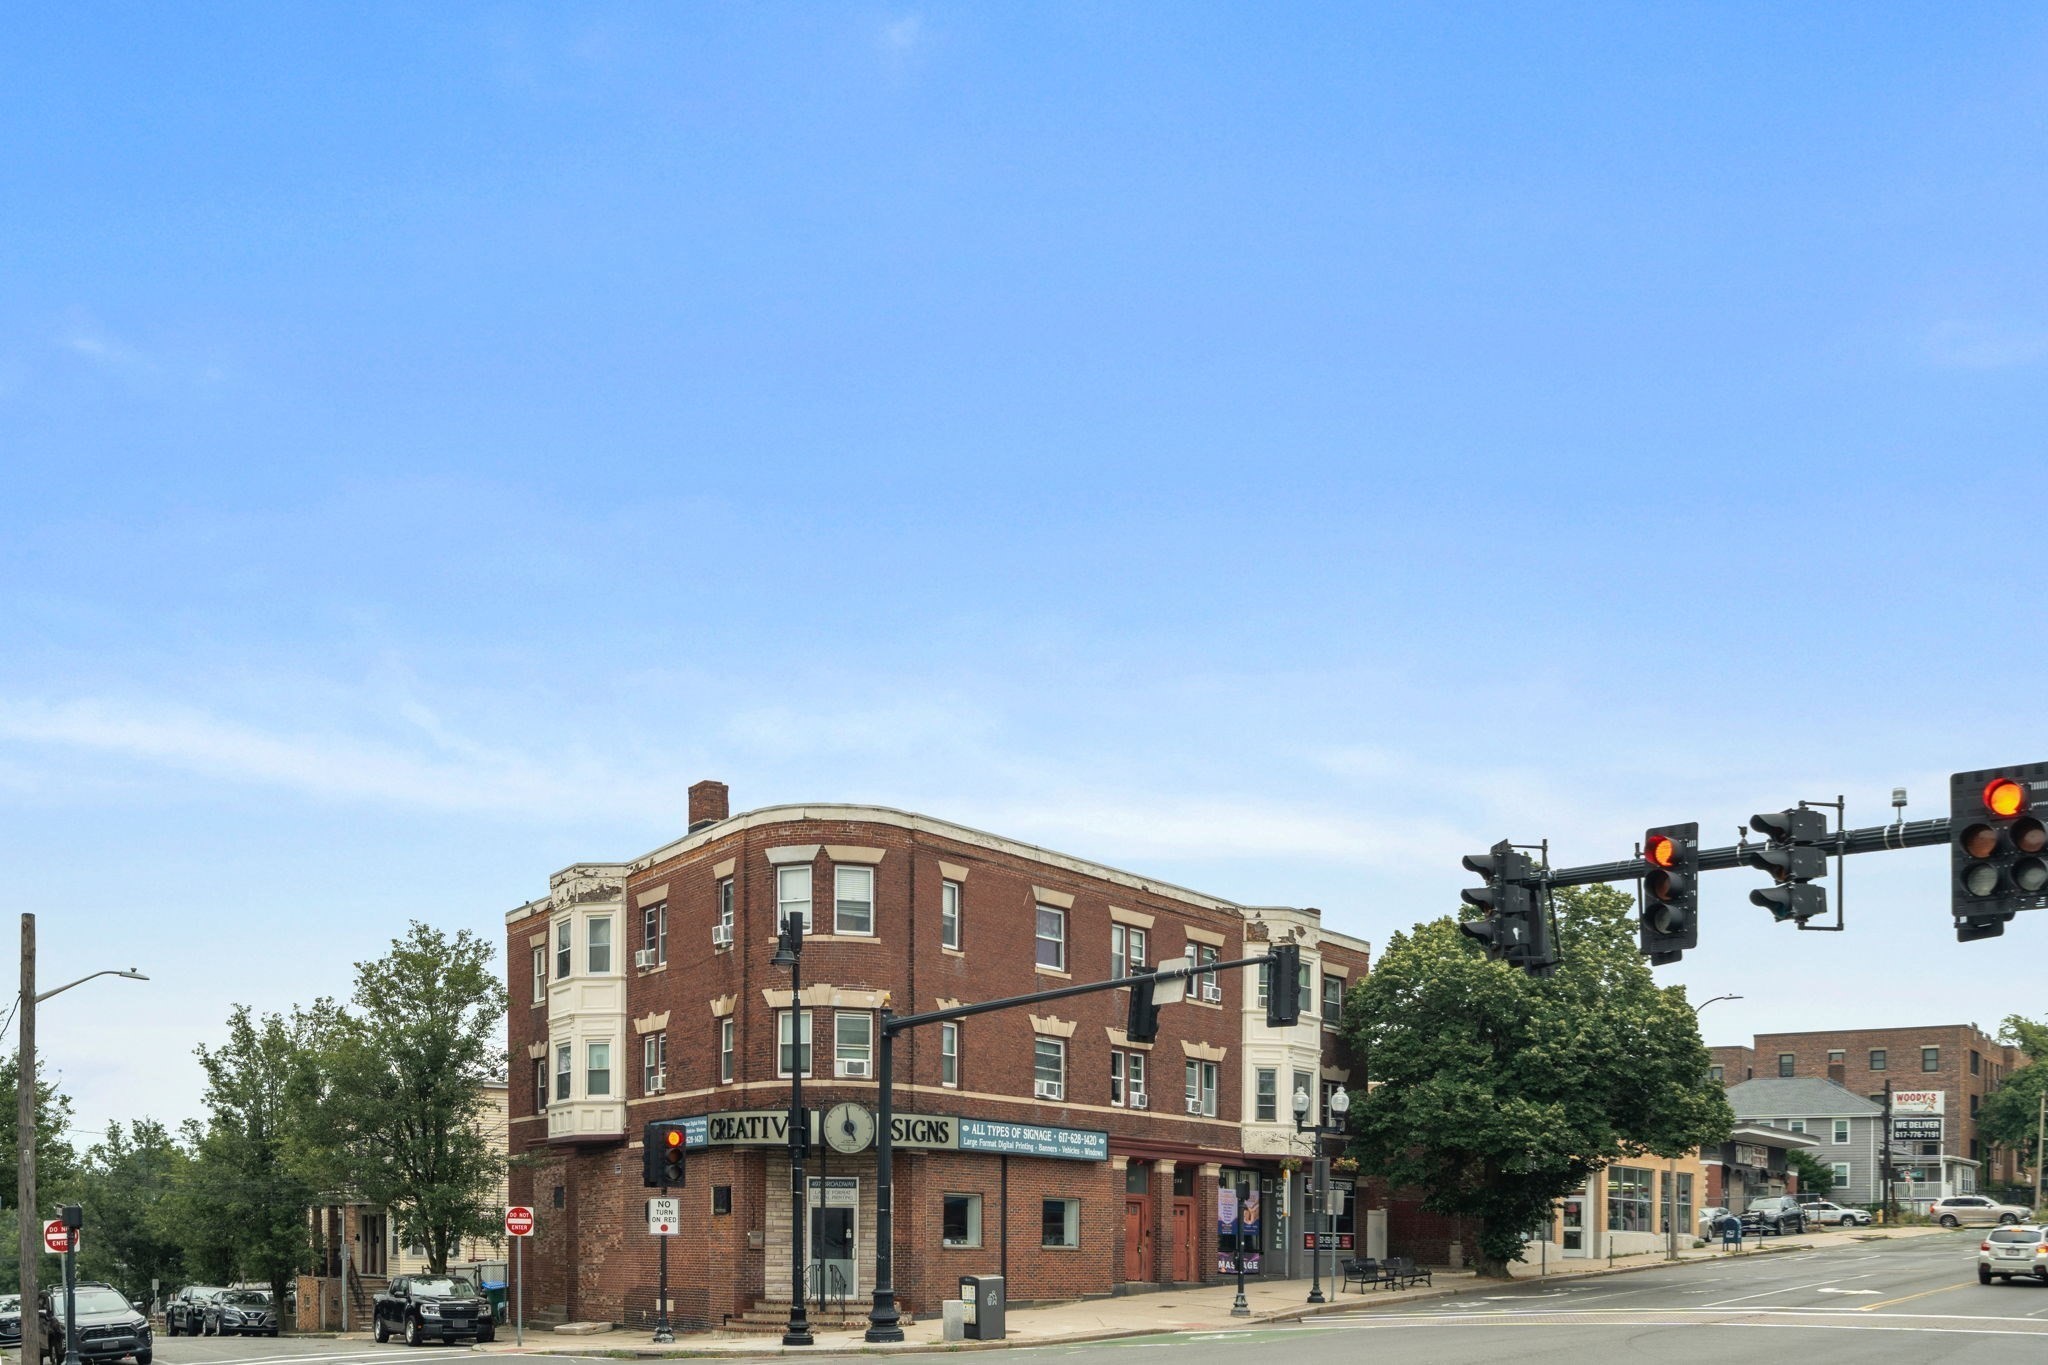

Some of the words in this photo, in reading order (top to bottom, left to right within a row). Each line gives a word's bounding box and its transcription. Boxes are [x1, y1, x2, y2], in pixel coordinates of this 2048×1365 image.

[1896, 1093, 1936, 1102] WOODY'S
[710, 1116, 788, 1141] CREATIV
[971, 1123, 985, 1135] ALL
[987, 1125, 1009, 1138] TYPES
[1011, 1127, 1021, 1138] OF
[1023, 1128, 1052, 1142] SIGNAGE
[1058, 1131, 1097, 1146] 617-628-1420
[1895, 1121, 1908, 1129] WE
[1909, 1121, 1940, 1129] DELIVER
[963, 1137, 978, 1148] Large
[979, 1138, 997, 1148] Format
[998, 1141, 1015, 1151] Digital
[1015, 1141, 1034, 1153] Printing
[1038, 1143, 1057, 1153] Banners
[1061, 1145, 1080, 1155] Vehicles
[1084, 1147, 1104, 1157] Windows
